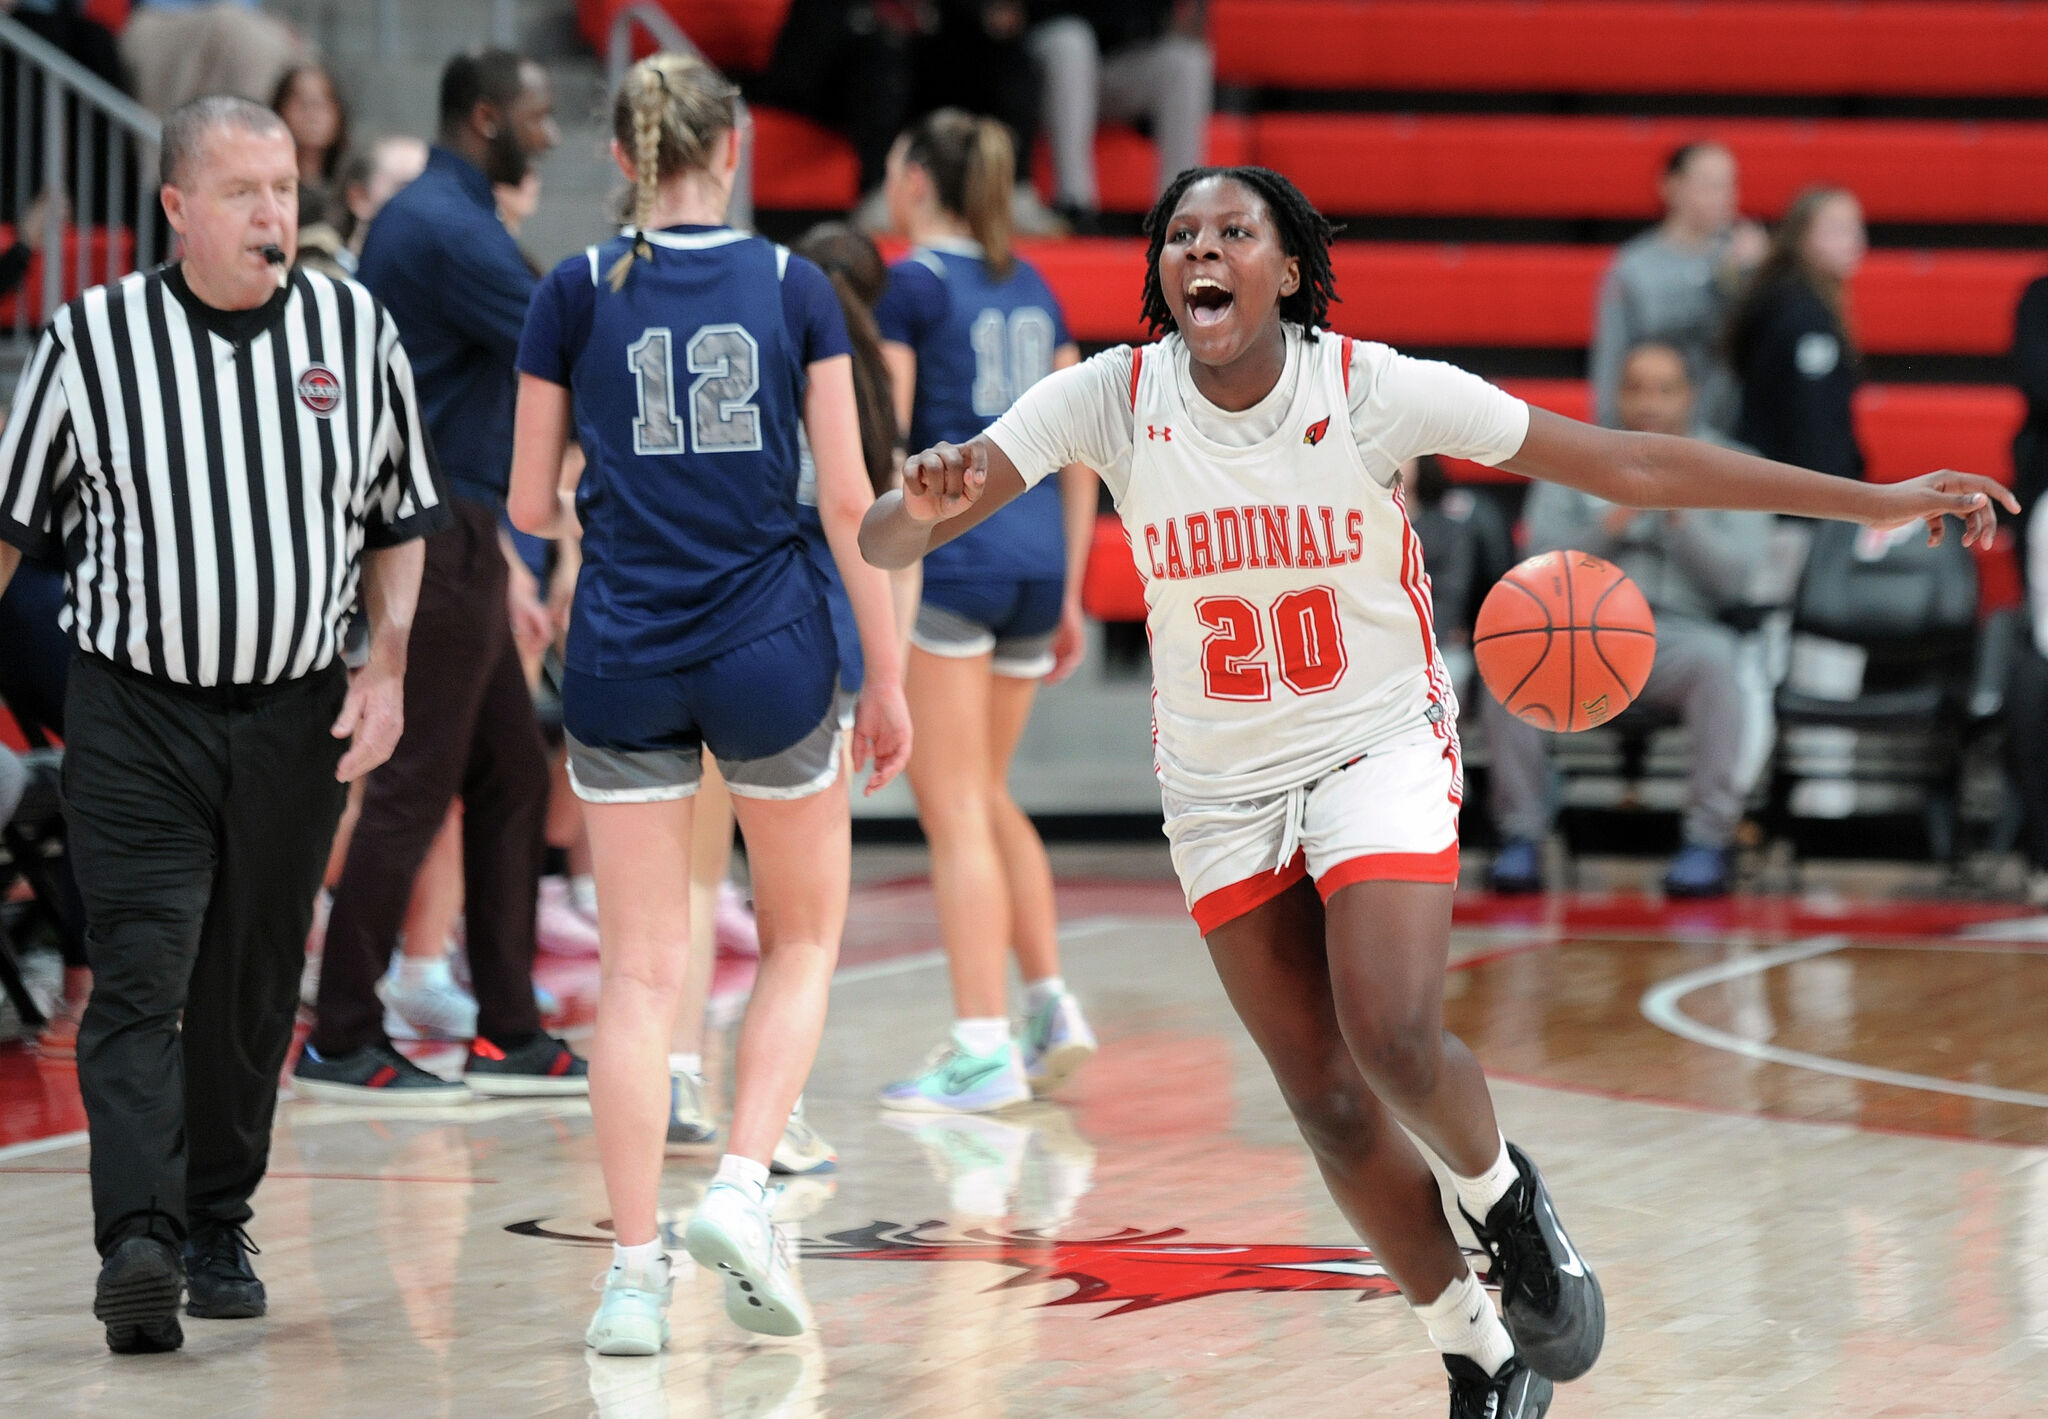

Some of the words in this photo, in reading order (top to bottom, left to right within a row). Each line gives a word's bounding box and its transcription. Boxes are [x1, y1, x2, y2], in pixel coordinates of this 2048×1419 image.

[626, 322, 763, 456] 12
[970, 305, 1056, 417] 10
[1144, 504, 1364, 581] CARDINALS
[1194, 584, 1348, 702] 20
